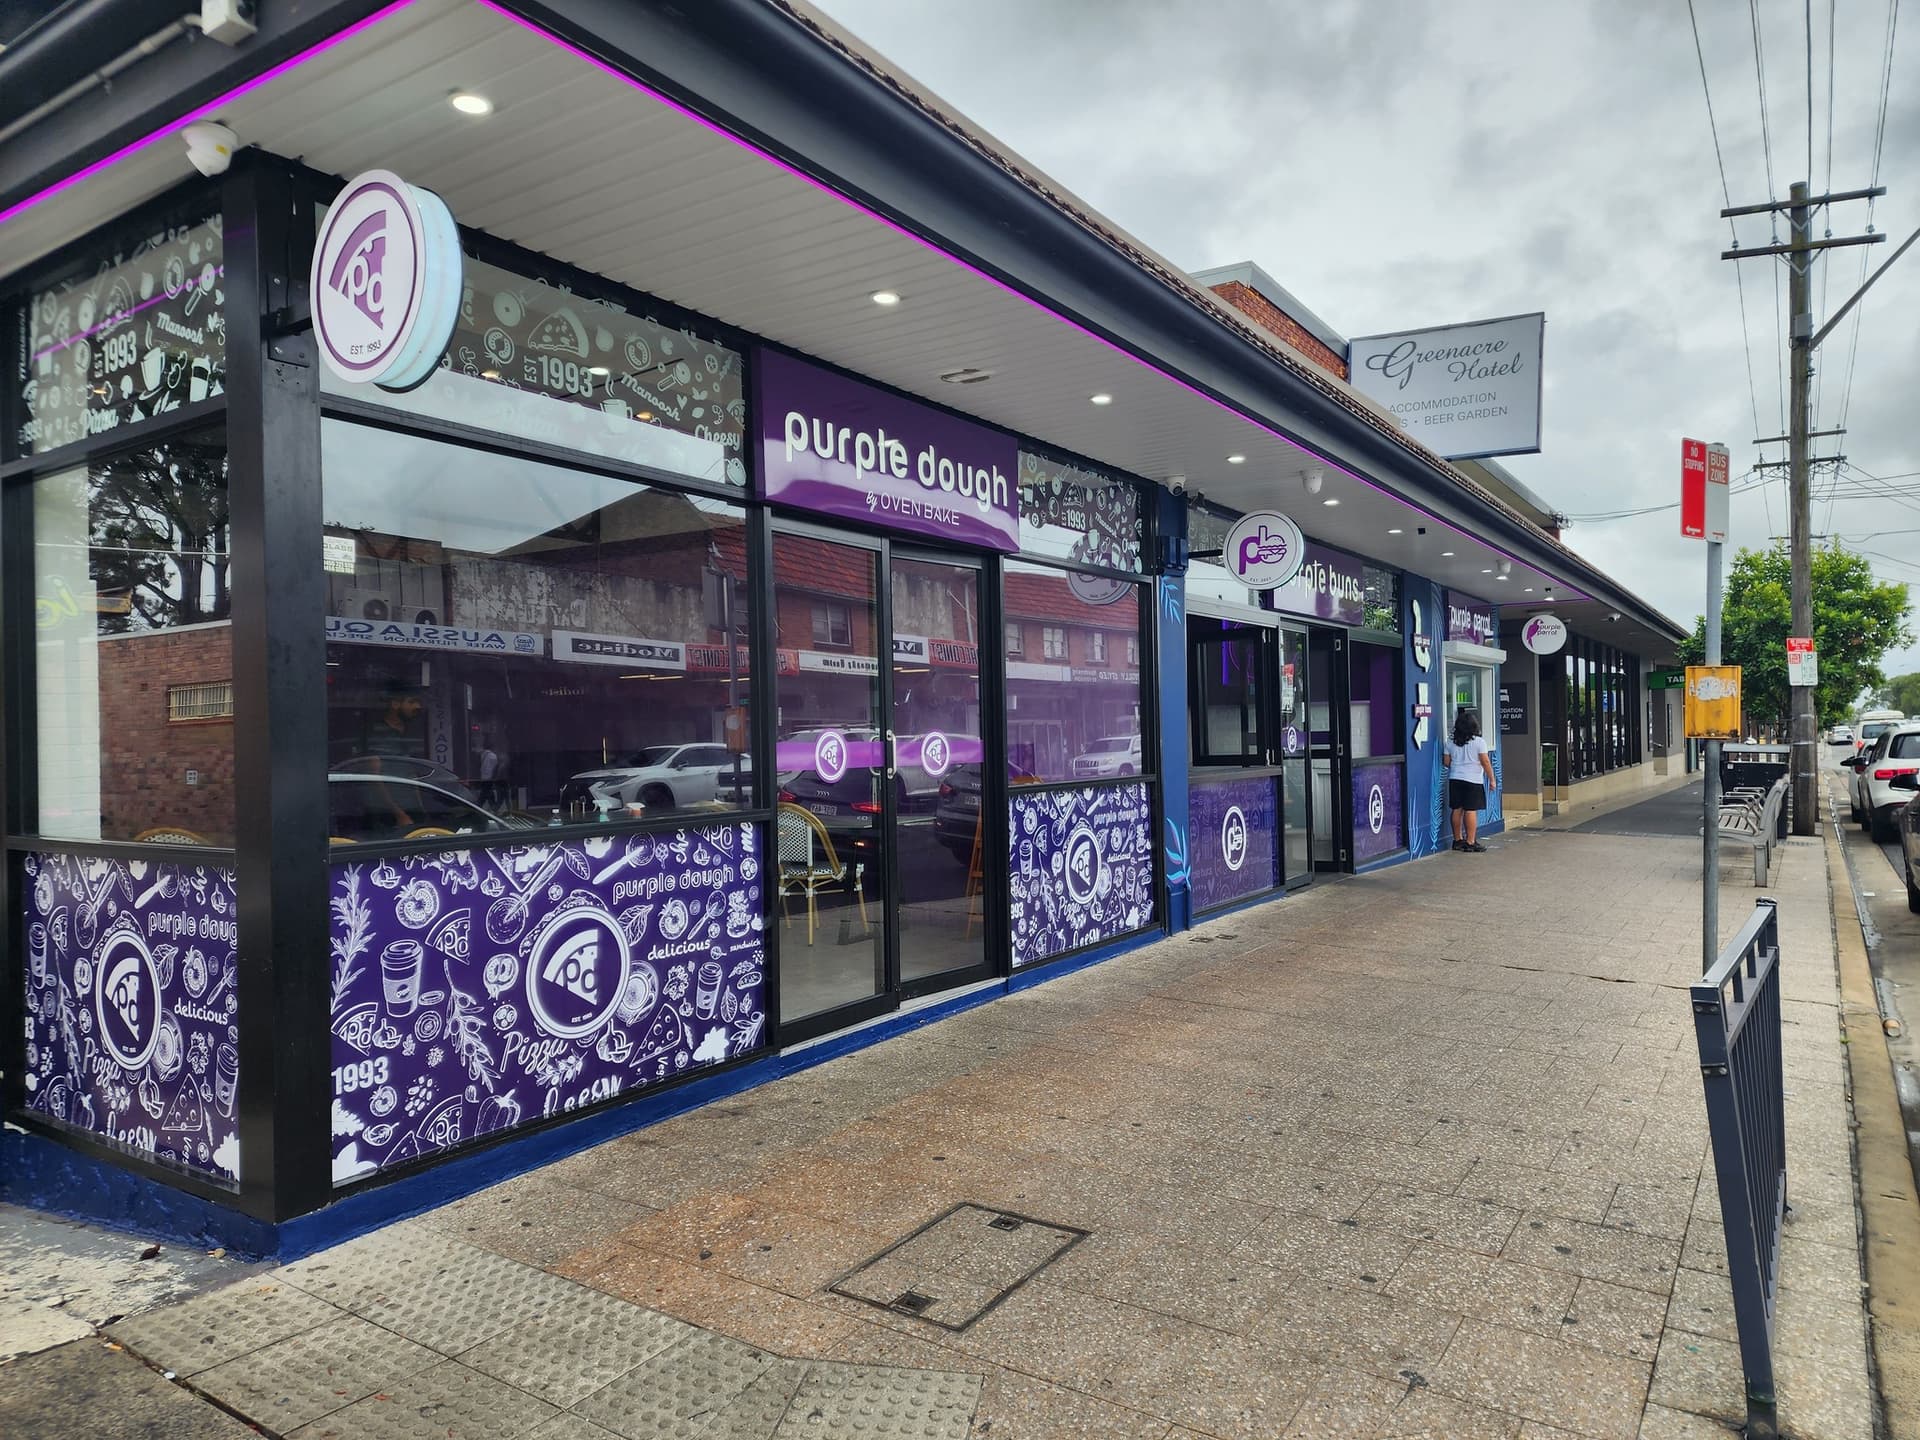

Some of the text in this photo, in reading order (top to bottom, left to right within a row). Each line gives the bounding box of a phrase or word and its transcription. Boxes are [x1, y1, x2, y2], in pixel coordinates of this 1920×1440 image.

[102, 330, 137, 374] 1993
[367, 340, 382, 353] 1993
[524, 355, 593, 397] EST 1993
[1365, 340, 1509, 391] Greenacre
[1447, 351, 1524, 382] Hotel
[621, 371, 681, 422] Manoosh
[1389, 391, 1497, 414] ACCOMMODATION
[1424, 411, 1455, 425] BEER
[1457, 406, 1508, 422] GARDEN
[695, 423, 741, 450] Cheesy
[1690, 446, 1698, 457] NO
[785, 411, 1008, 512] purple dough
[1710, 453, 1727, 468] BUS
[1710, 468, 1726, 483] ZONE
[866, 491, 960, 525] By OVEN BAKE
[1067, 509, 1086, 531] 1993
[1329, 564, 1359, 602] buns
[613, 864, 733, 904] purple dough
[148, 910, 196, 940] purple
[648, 938, 710, 961] delicious
[174, 997, 229, 1025] delicious
[83, 1037, 121, 1088] Pizza
[500, 1031, 568, 1074] Pizza
[331, 1056, 389, 1094] 1993
